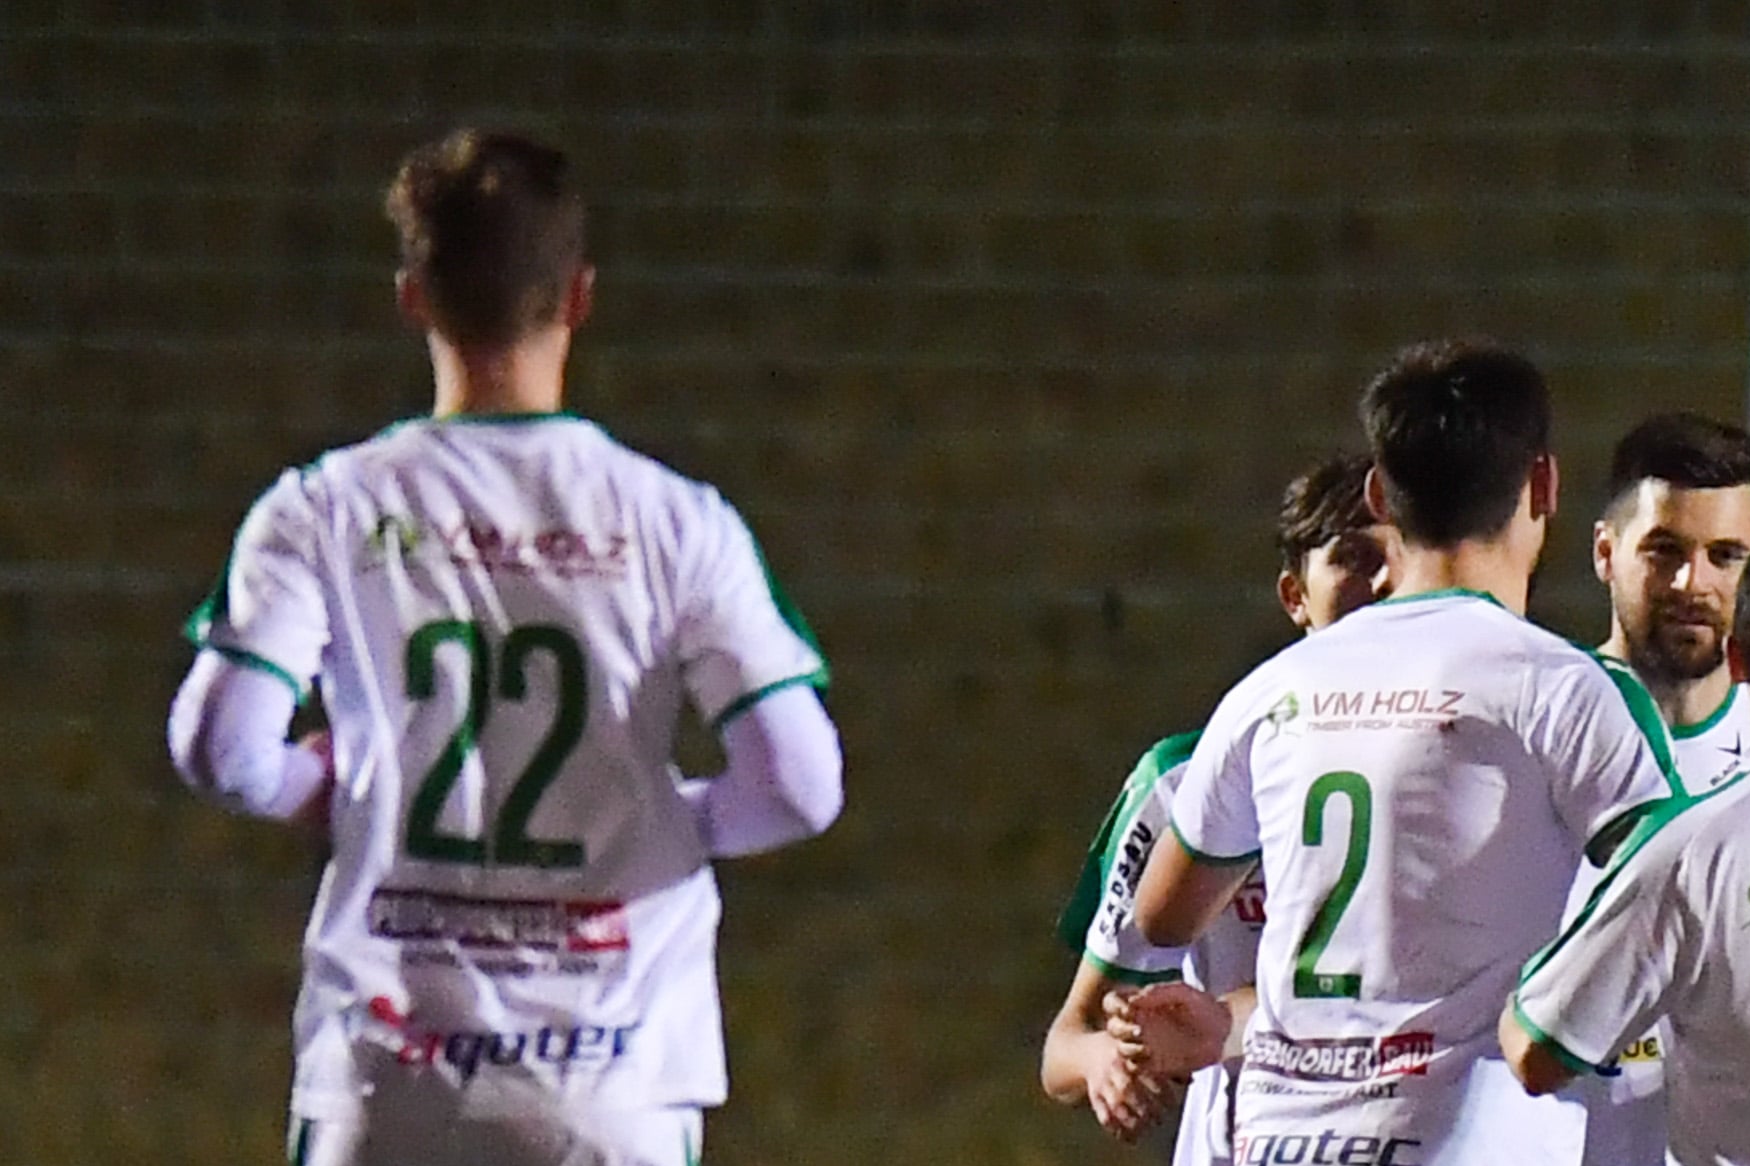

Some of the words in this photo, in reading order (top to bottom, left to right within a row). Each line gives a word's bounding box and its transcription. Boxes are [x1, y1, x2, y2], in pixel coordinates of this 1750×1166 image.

[405, 619, 588, 868] 22
[1313, 691, 1365, 716] VM
[1370, 689, 1466, 716] HOLZ
[1293, 771, 1372, 999] 2
